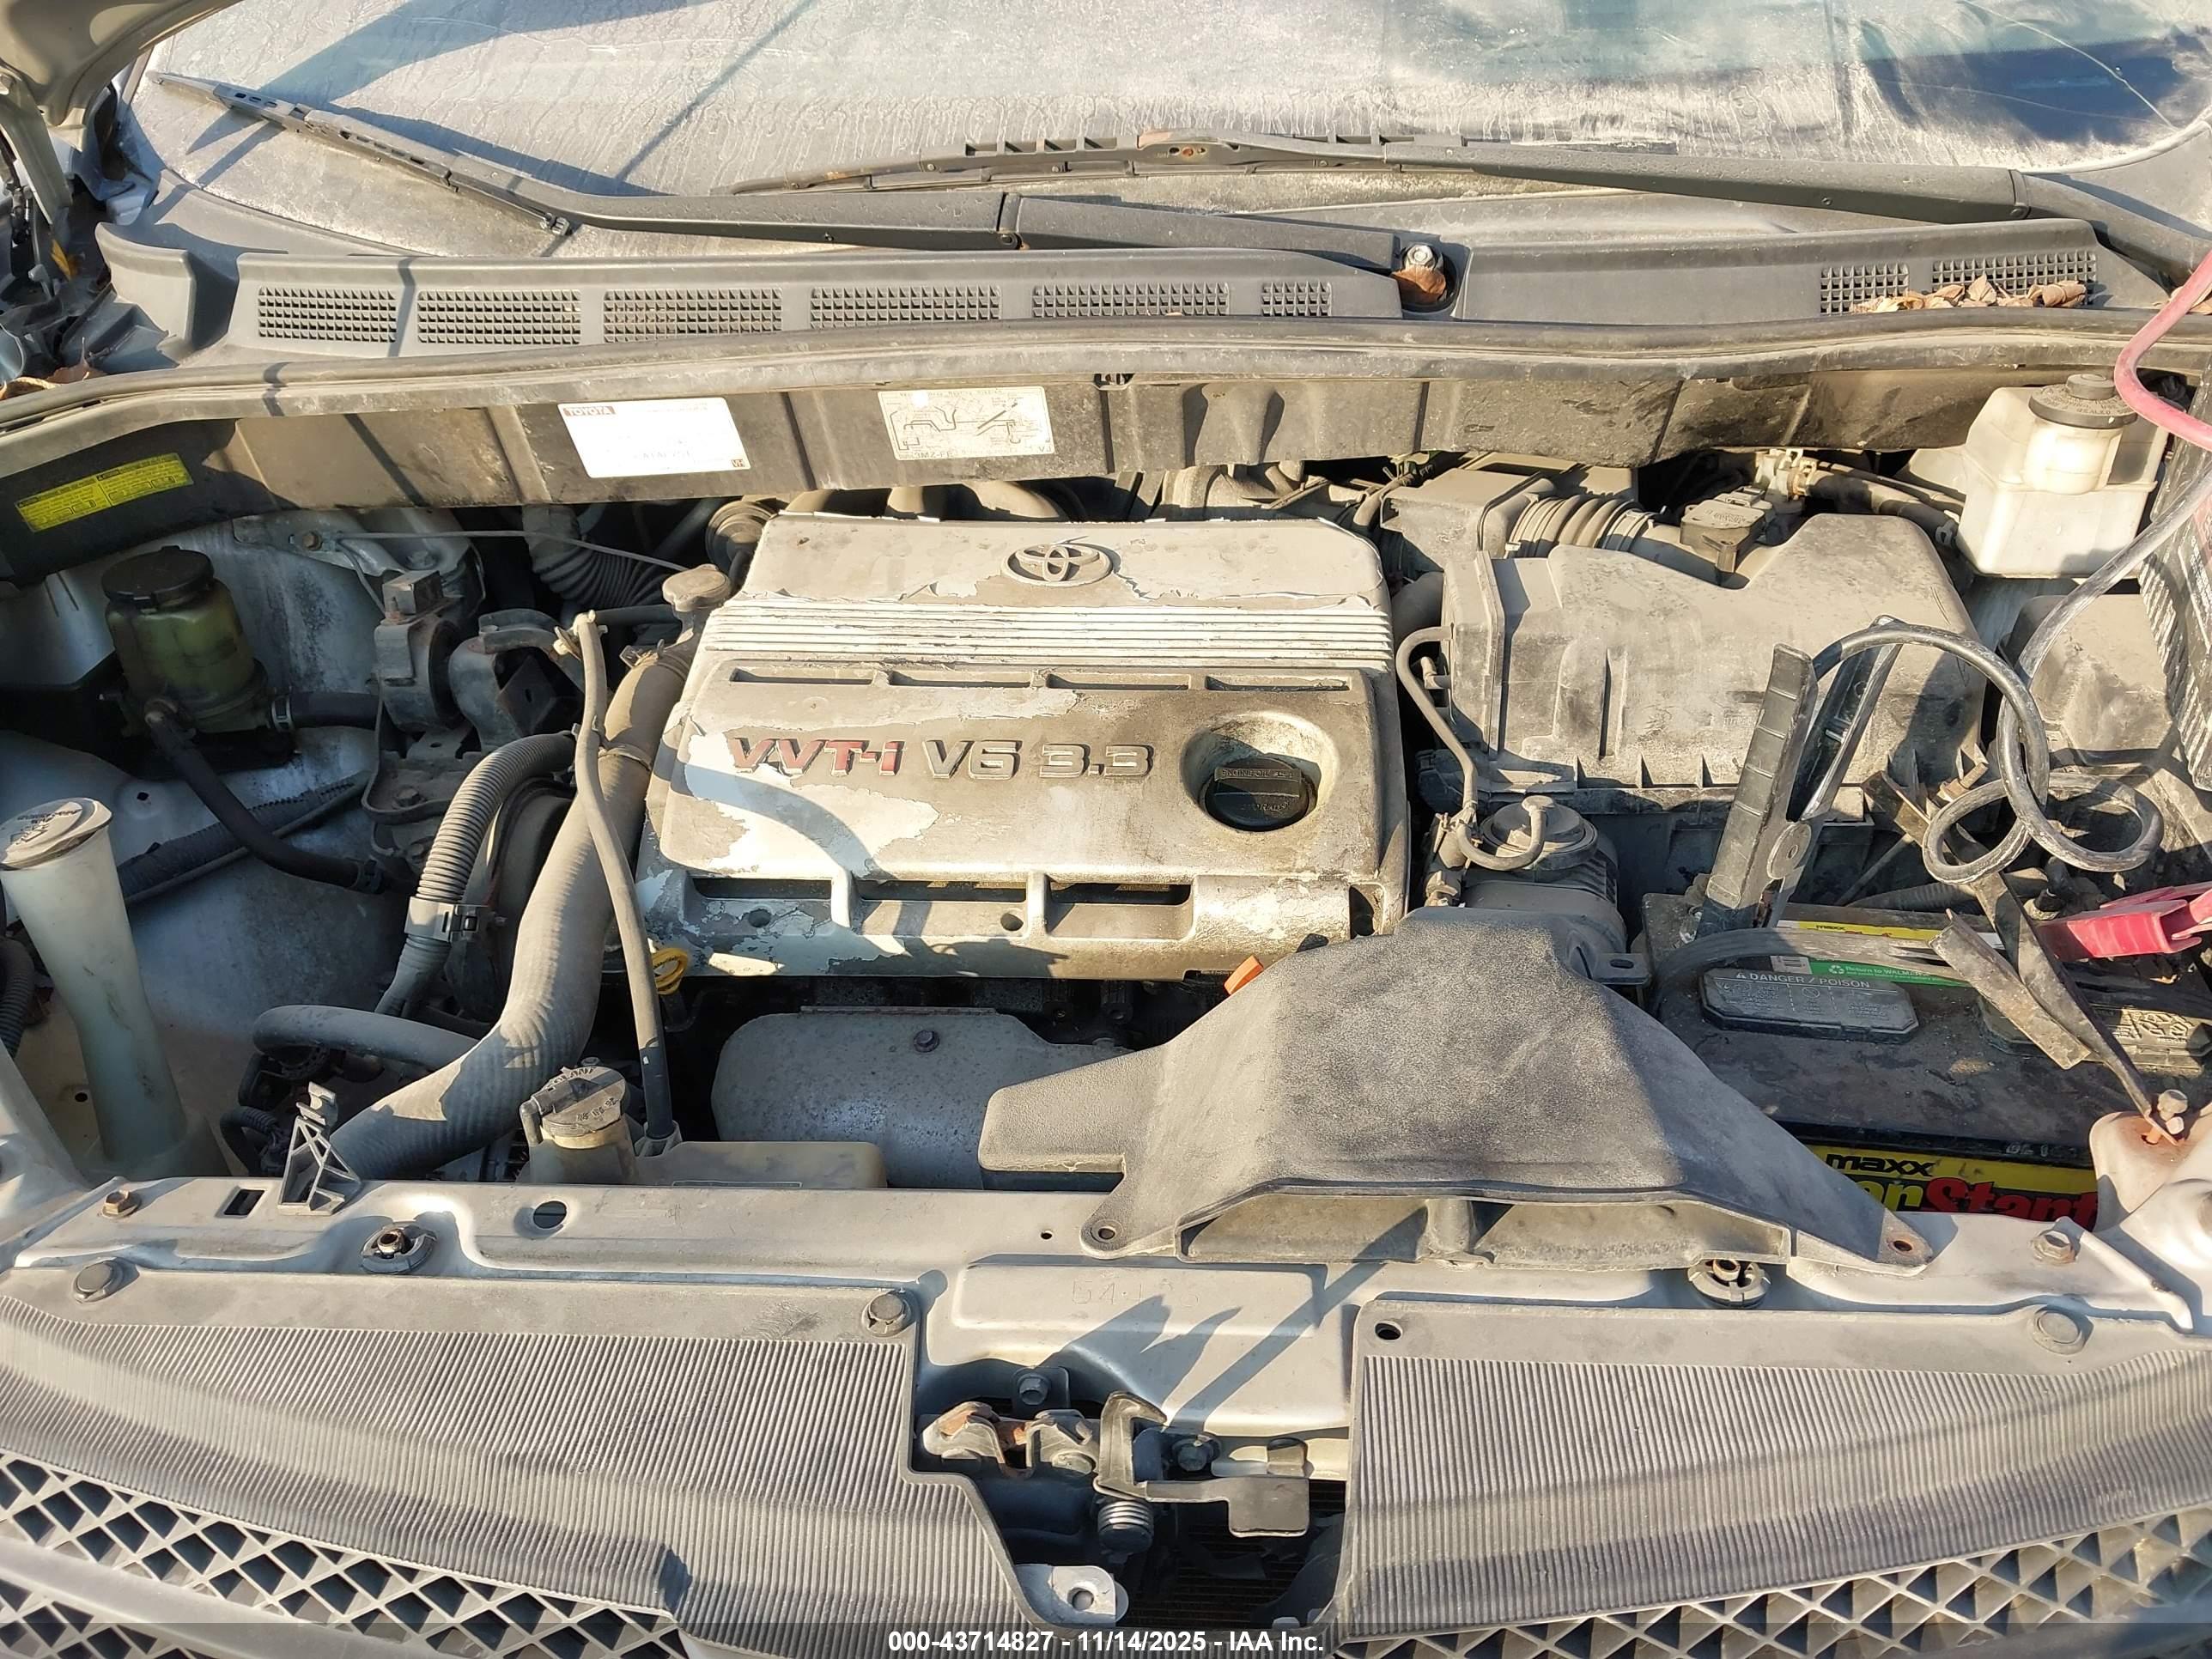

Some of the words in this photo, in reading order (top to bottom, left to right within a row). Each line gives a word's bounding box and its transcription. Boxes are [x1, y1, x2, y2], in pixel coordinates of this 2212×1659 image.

[567, 405, 611, 417] TOYOTA
[922, 738, 1023, 781] V6
[1038, 742, 1155, 780] 3.3
[1845, 965, 1871, 974] Return
[1749, 972, 1805, 983] DANGER
[1820, 977, 1871, 988] POISON
[1826, 1152, 1936, 1178] maxx
